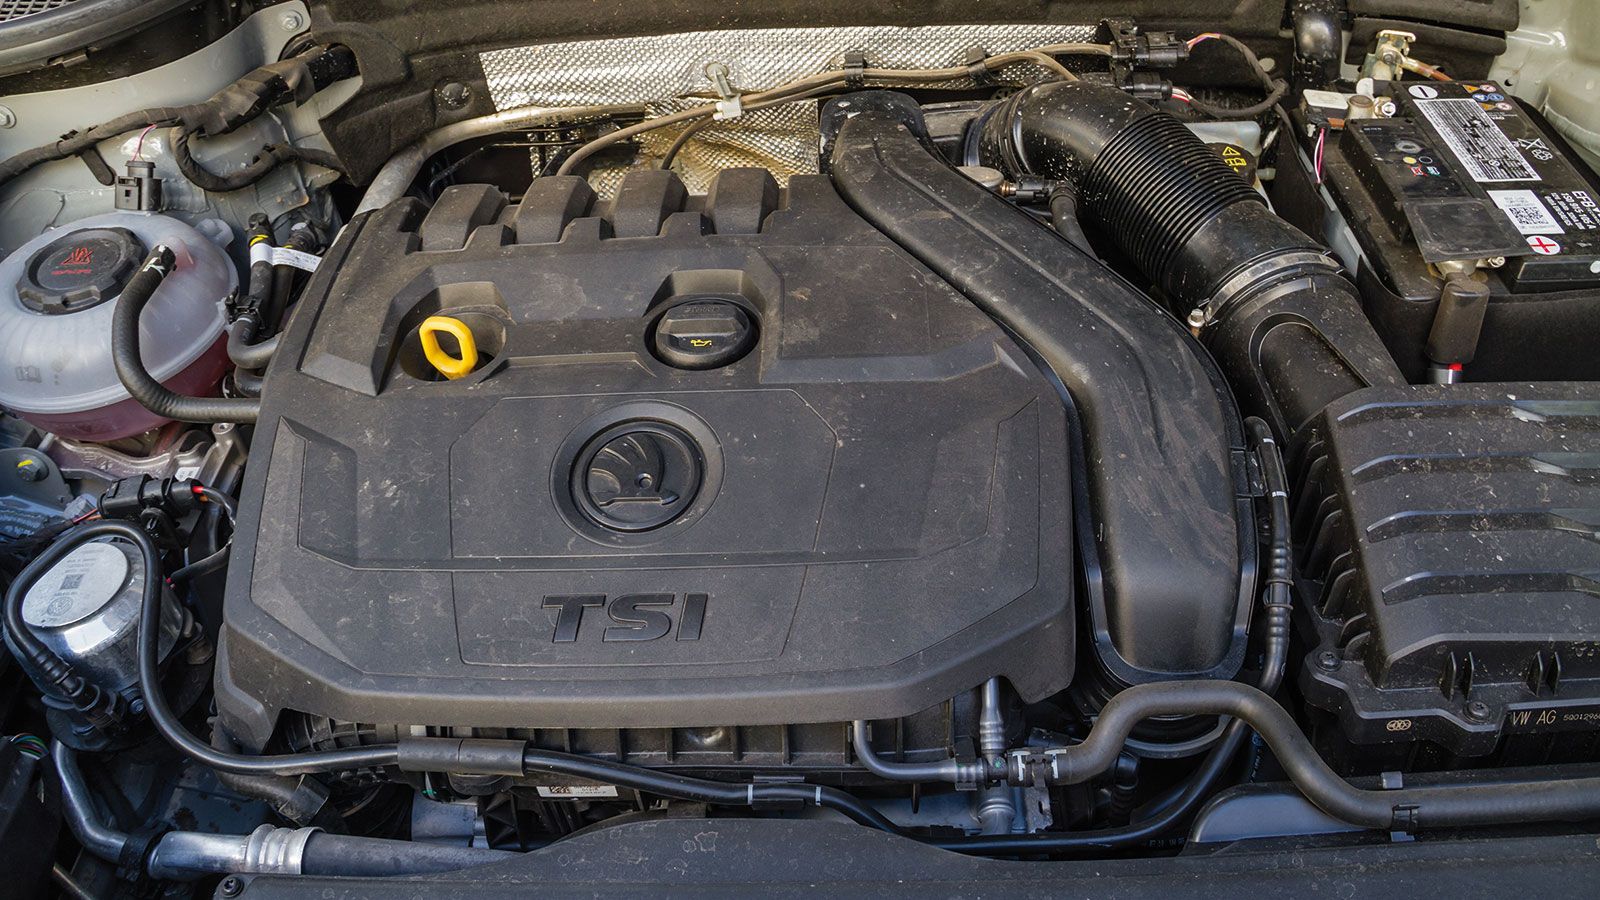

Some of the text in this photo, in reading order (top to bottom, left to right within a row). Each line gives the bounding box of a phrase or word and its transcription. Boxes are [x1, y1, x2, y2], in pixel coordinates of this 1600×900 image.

[1571, 191, 1596, 207] EFB
[541, 593, 709, 643] TSI
[1512, 711, 1532, 725] VW
[1536, 709, 1557, 725] AG
